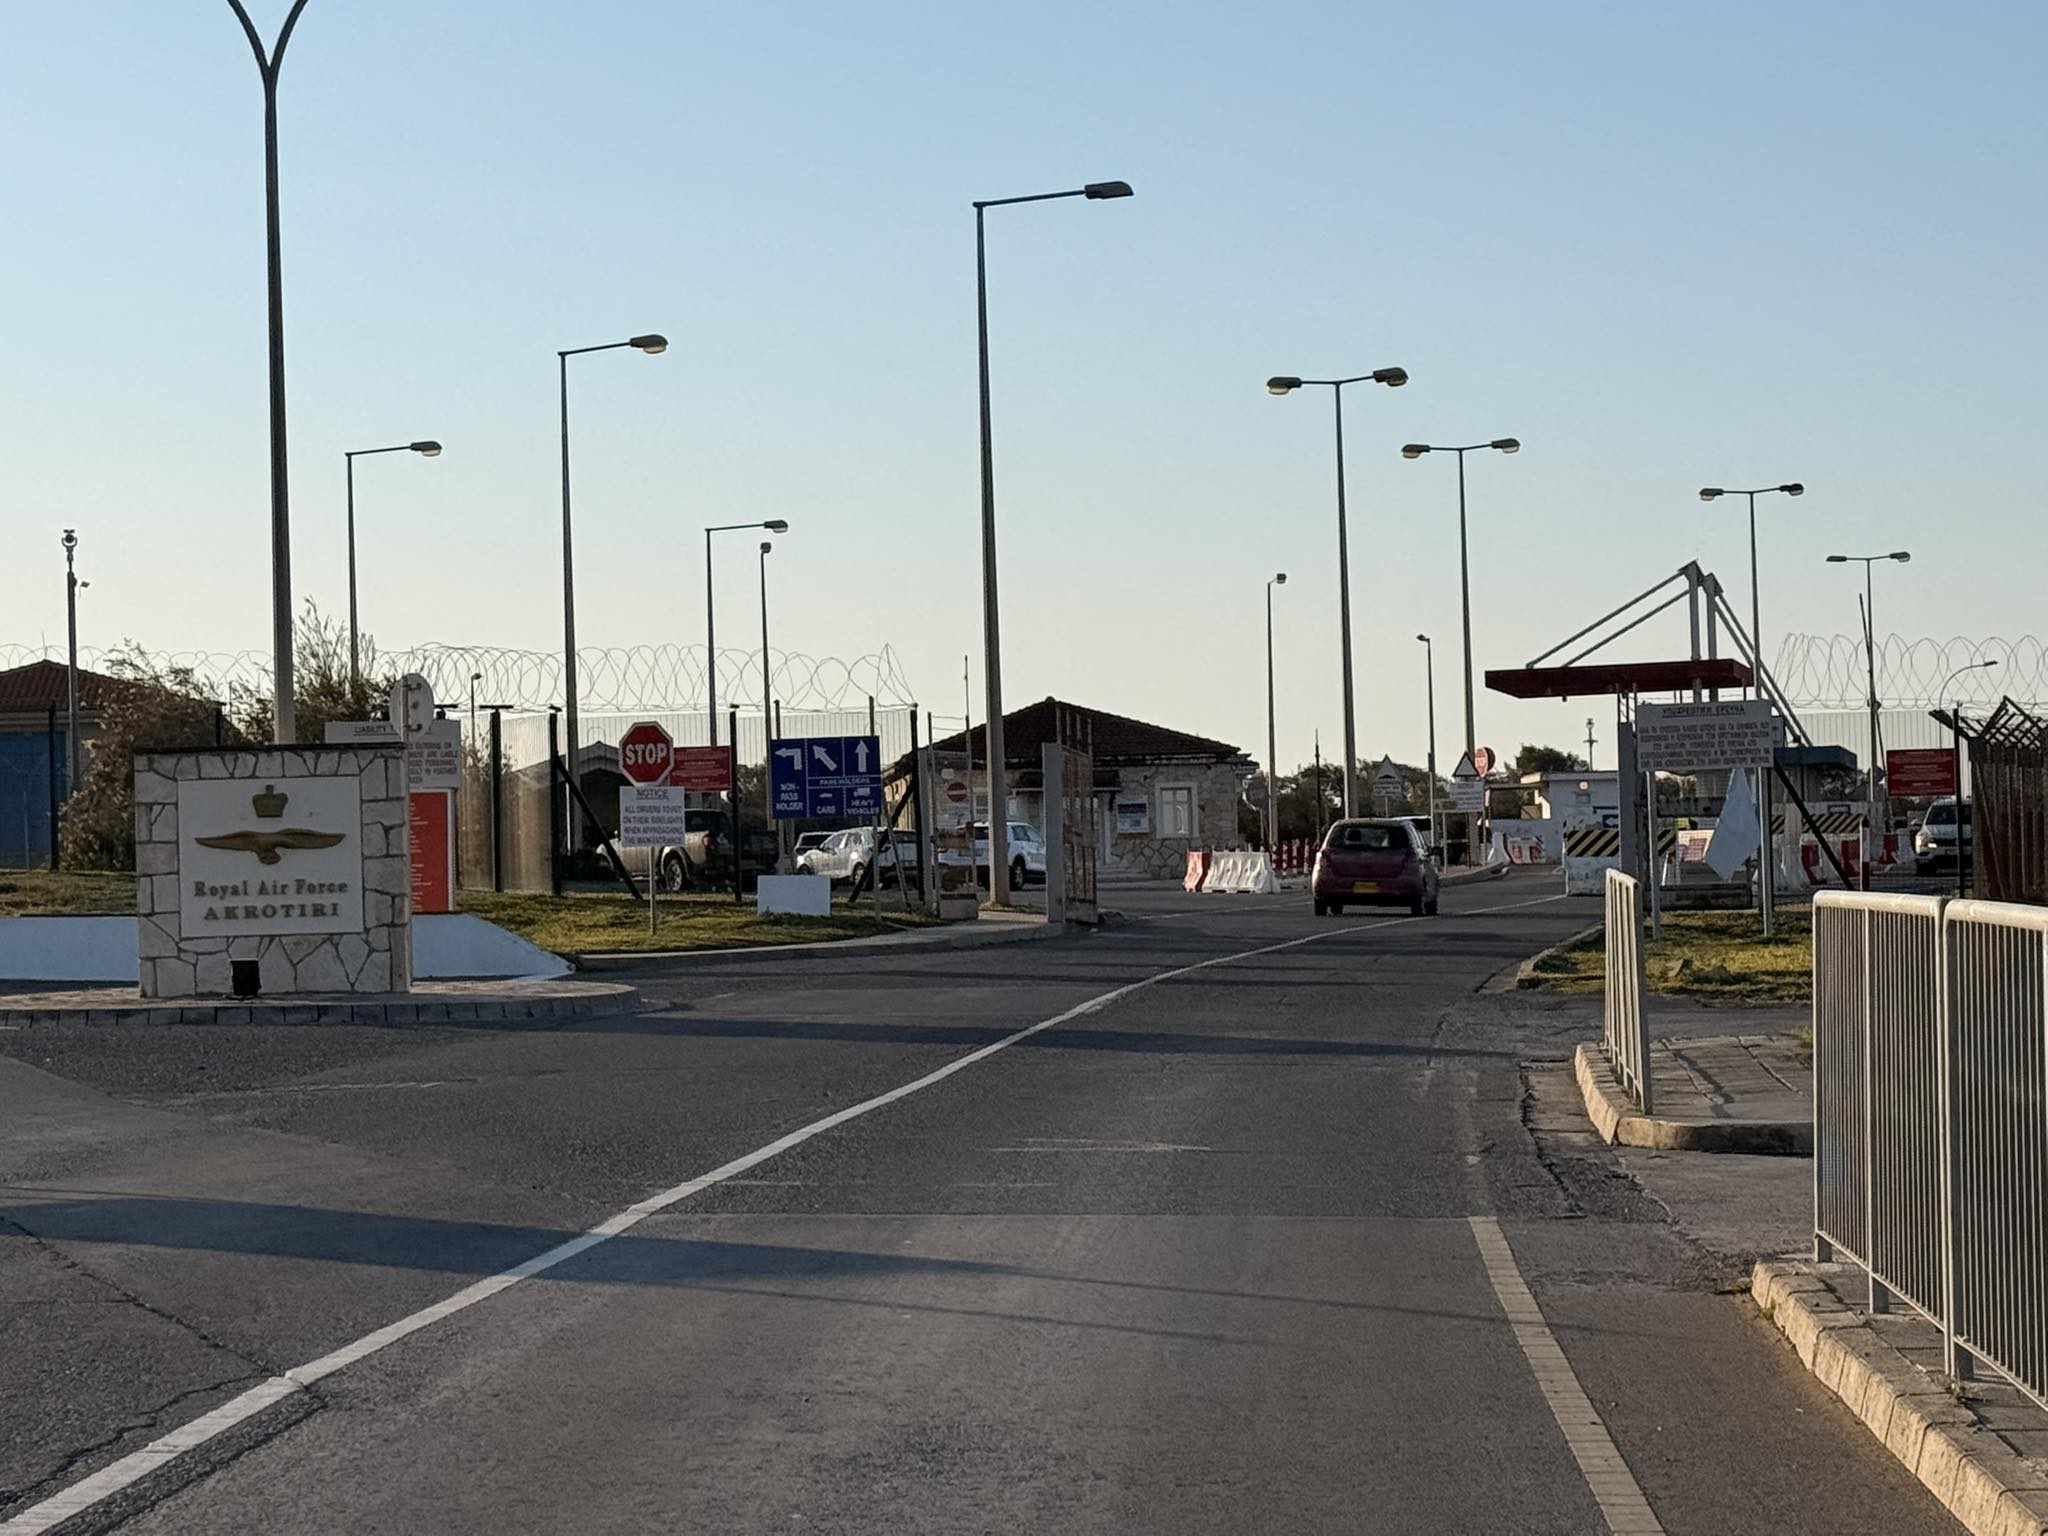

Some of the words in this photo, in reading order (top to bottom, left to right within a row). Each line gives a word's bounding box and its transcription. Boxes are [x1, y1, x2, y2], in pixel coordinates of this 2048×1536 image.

[624, 743, 667, 766] STOP
[636, 788, 668, 798] NOTICE
[781, 792, 799, 801] PASS
[775, 802, 804, 811] HOLDER
[851, 799, 875, 807] HEAVY
[816, 805, 836, 814] CARS
[847, 806, 880, 815] VEHICLES
[194, 880, 249, 900] Royal
[258, 880, 289, 896] Air
[294, 879, 348, 895] Force
[204, 902, 340, 920] AKROTIRI
